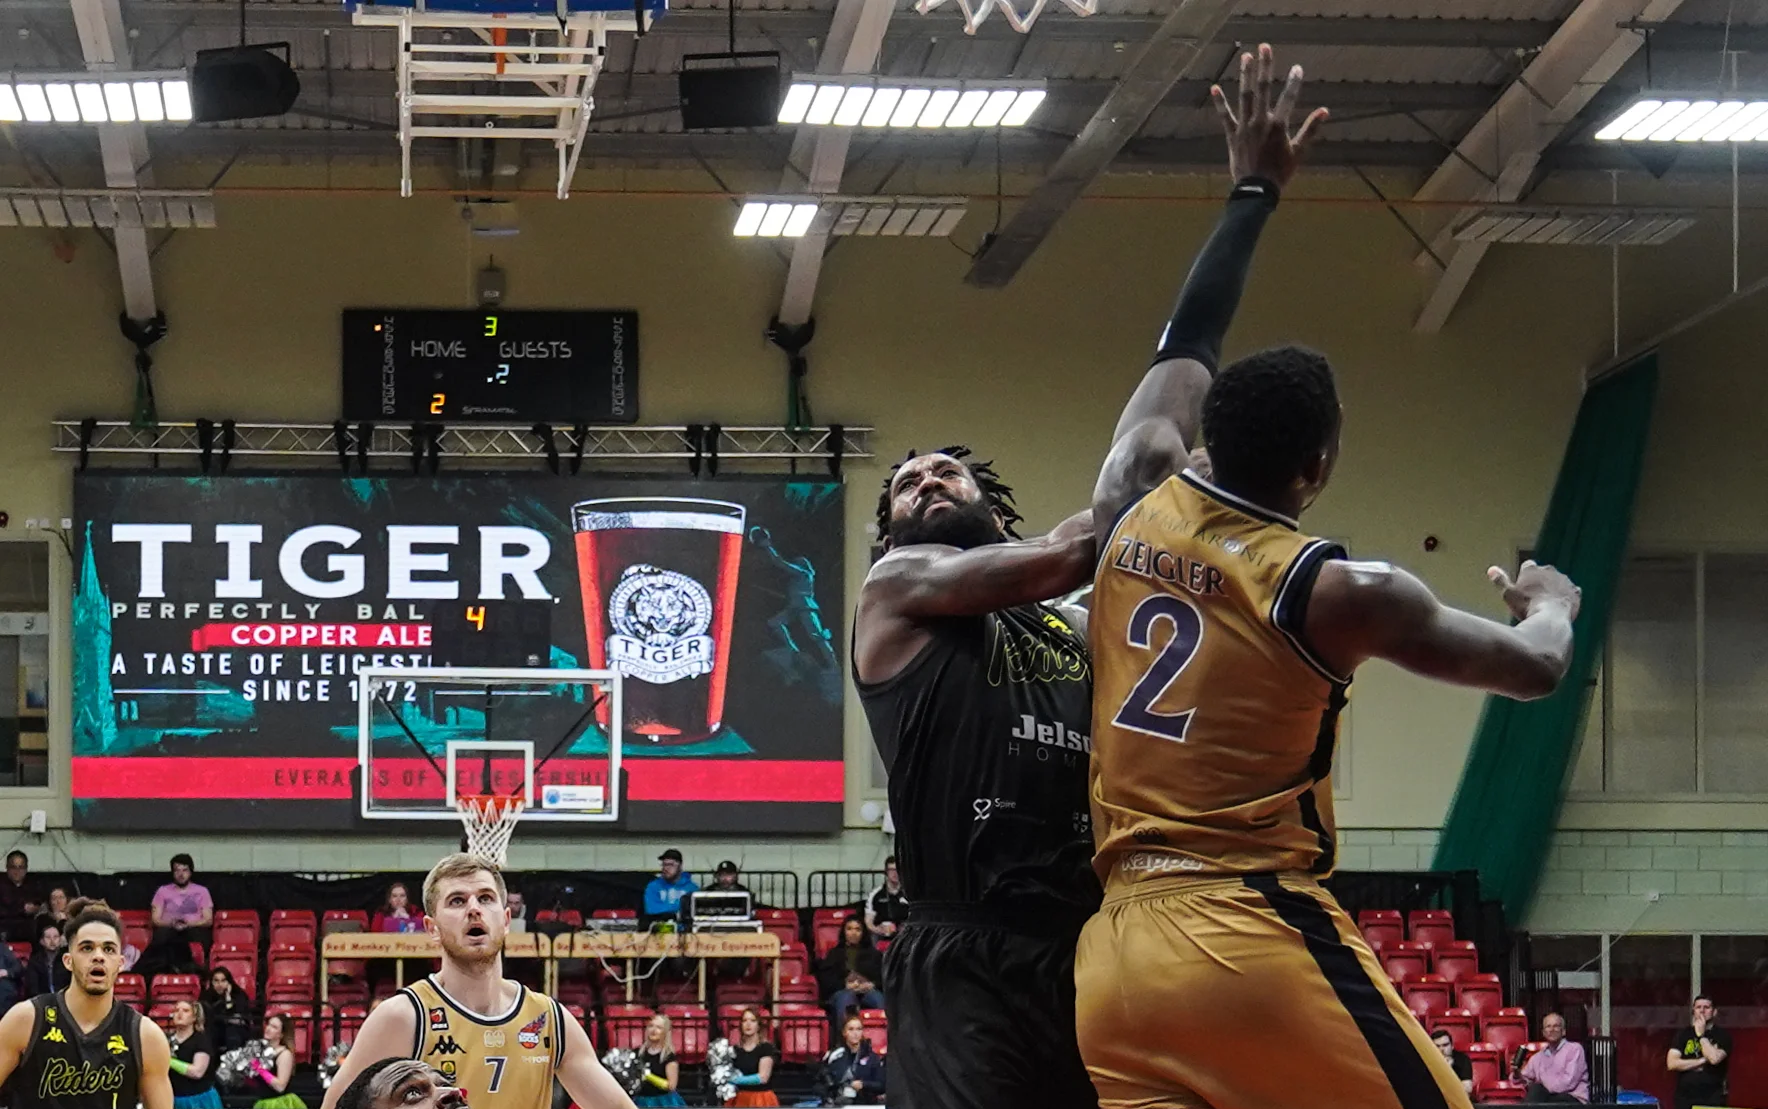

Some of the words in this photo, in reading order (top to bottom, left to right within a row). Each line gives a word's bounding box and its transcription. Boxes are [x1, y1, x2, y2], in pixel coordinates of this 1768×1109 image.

[484, 316, 498, 337] 3
[411, 341, 467, 358] HOME
[499, 341, 572, 358] GUESTS
[430, 394, 445, 414] 2
[1112, 534, 1227, 597] ZEIGLER
[112, 603, 322, 619] PERFECTLY
[357, 603, 425, 620] BAL
[465, 606, 487, 631] 4
[231, 625, 357, 646] COPPER
[377, 626, 433, 646] ALE
[620, 638, 701, 664] TIGER
[111, 653, 127, 675] A
[144, 653, 232, 675] TASTE
[250, 653, 284, 675] OF
[302, 653, 433, 675] LEICEST
[1111, 592, 1204, 743] 2
[243, 680, 330, 701] SINCE
[348, 681, 417, 701] 172
[274, 769, 390, 787] EVERAS
[402, 770, 428, 787] OF
[994, 797, 1017, 810] Spire
[38, 1057, 125, 1099] Riders
[483, 1055, 508, 1094] 7
